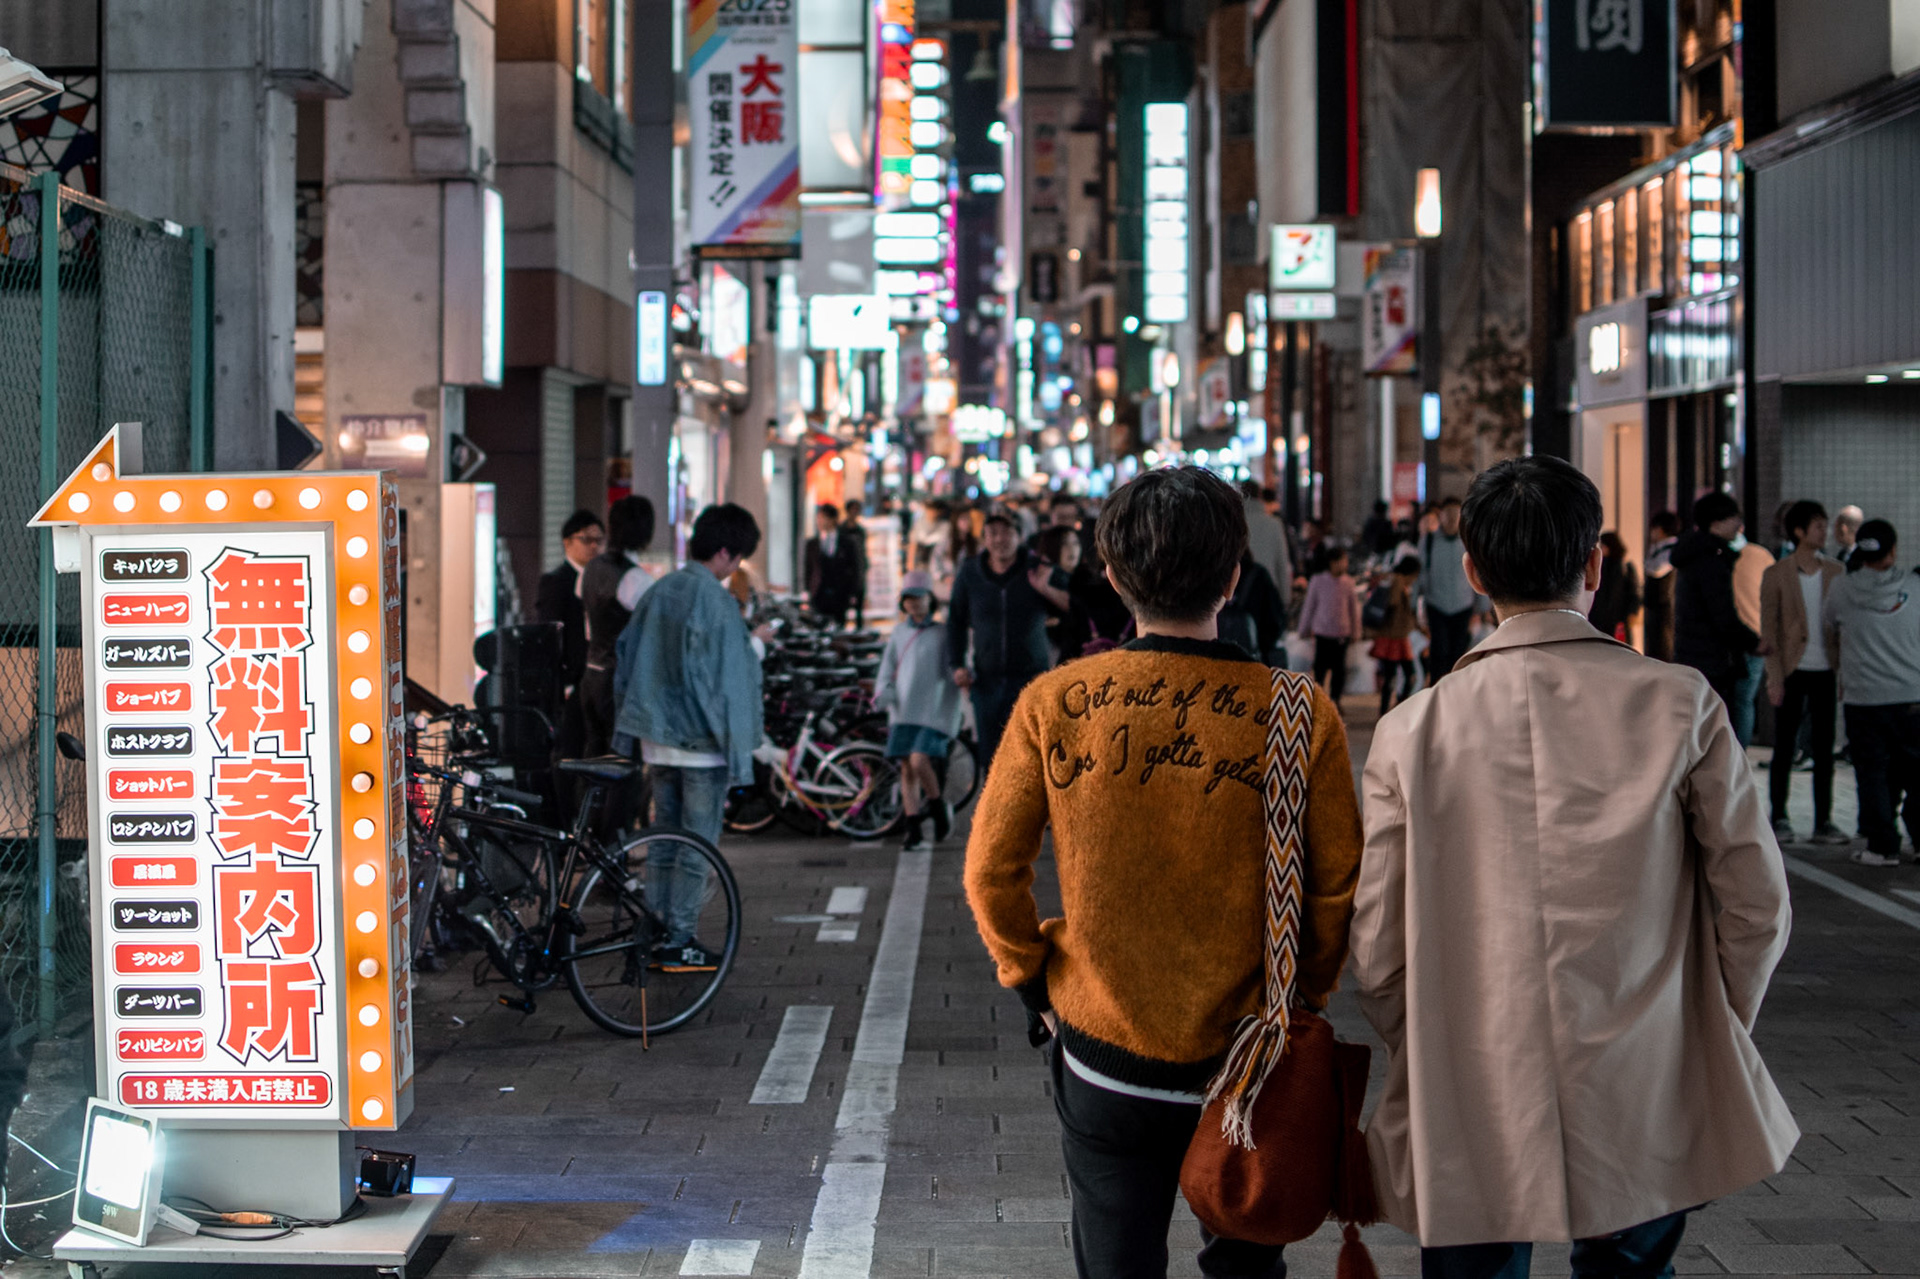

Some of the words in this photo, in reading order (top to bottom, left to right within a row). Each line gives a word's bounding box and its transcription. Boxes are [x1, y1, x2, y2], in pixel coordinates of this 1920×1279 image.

[739, 53, 784, 145] 大阪
[113, 558, 179, 574] キャバクラ
[107, 602, 187, 616] ニューハーフ
[106, 645, 191, 662] ガールズバー
[116, 689, 182, 706] ショーパブ
[1063, 676, 1117, 721] Get
[1123, 678, 1168, 709] out
[1172, 679, 1206, 730] of
[1211, 683, 1249, 718] the
[111, 732, 189, 750] ホストクラブ
[1050, 739, 1097, 789] Cos
[1140, 731, 1207, 785] gotta
[115, 776, 188, 793] ショットバー
[211, 554, 317, 1057] 無料案内所
[112, 820, 194, 837] ロシアンパブ
[120, 908, 192, 923] ツーショット
[132, 951, 185, 967] ラウンジ
[124, 994, 196, 1010] ダーツバー
[119, 1037, 204, 1053] フィリピンパブ
